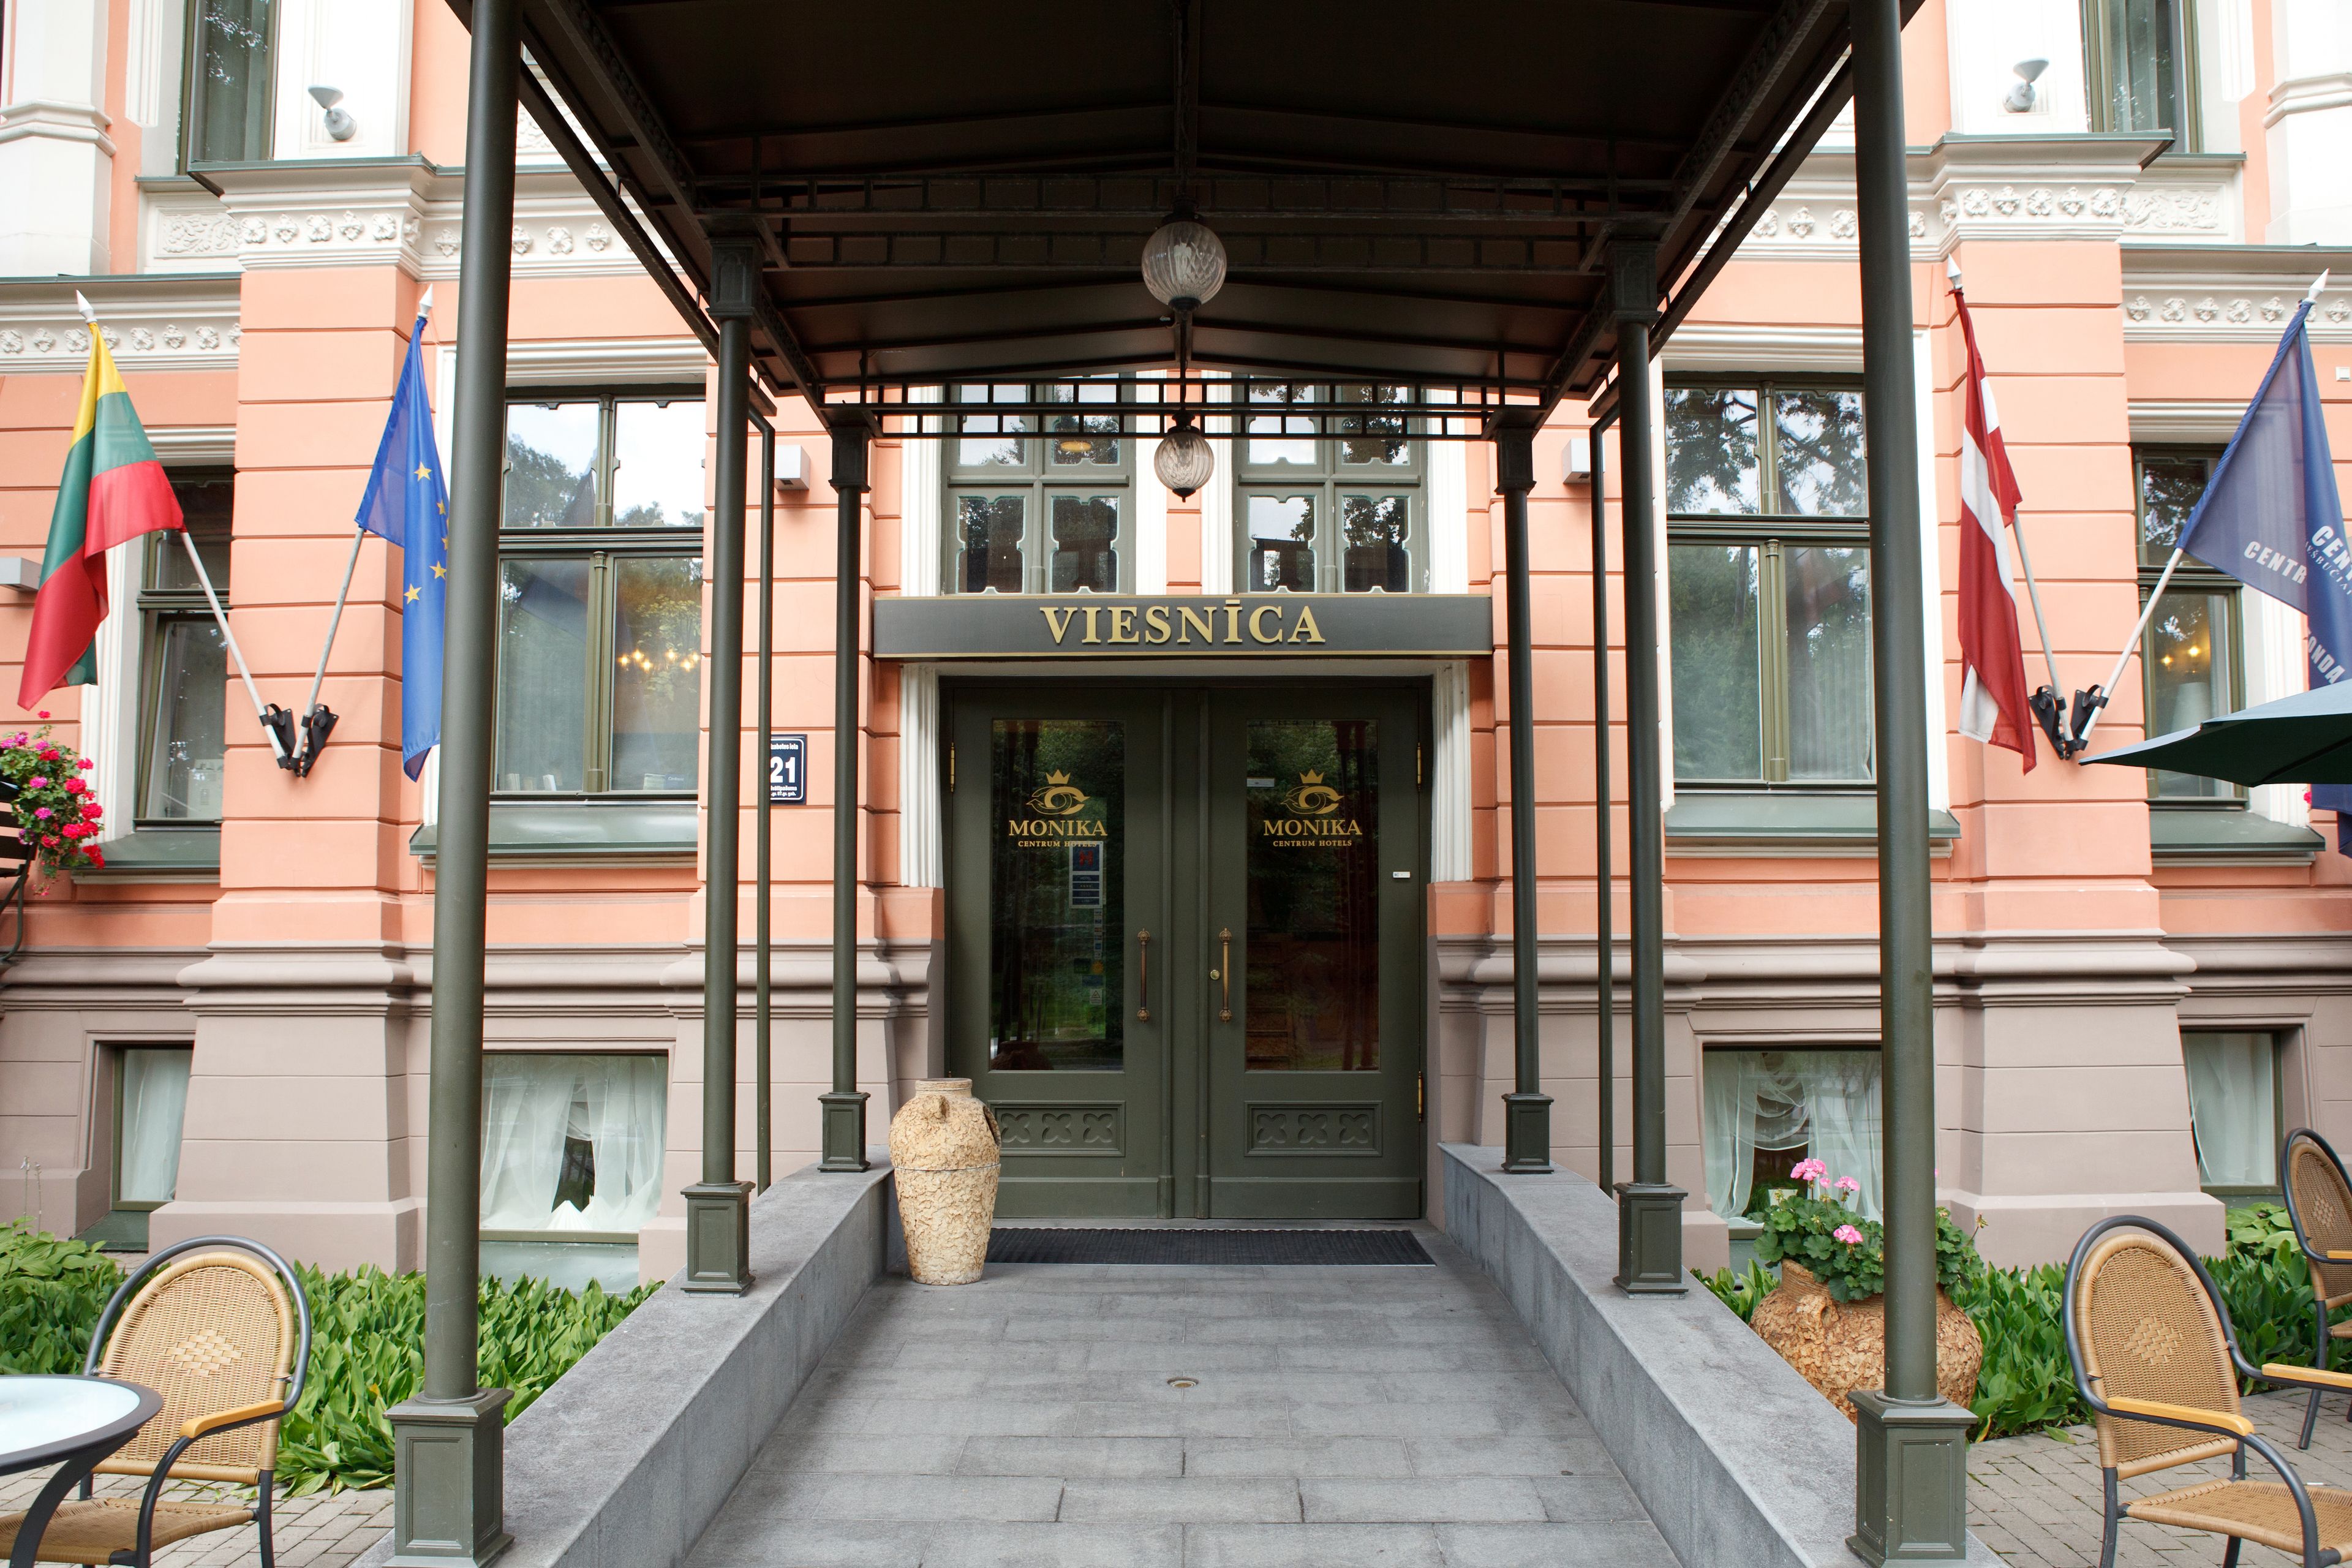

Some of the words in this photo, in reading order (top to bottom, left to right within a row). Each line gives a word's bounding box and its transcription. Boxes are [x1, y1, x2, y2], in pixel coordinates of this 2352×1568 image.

[2244, 541, 2307, 584] CENTR
[1040, 600, 1325, 644] VIESNĪCA
[2307, 627, 2345, 684] ONDA
[770, 756, 796, 783] 21
[1009, 820, 1108, 836] MONIKA
[1264, 820, 1363, 835] MONIKA
